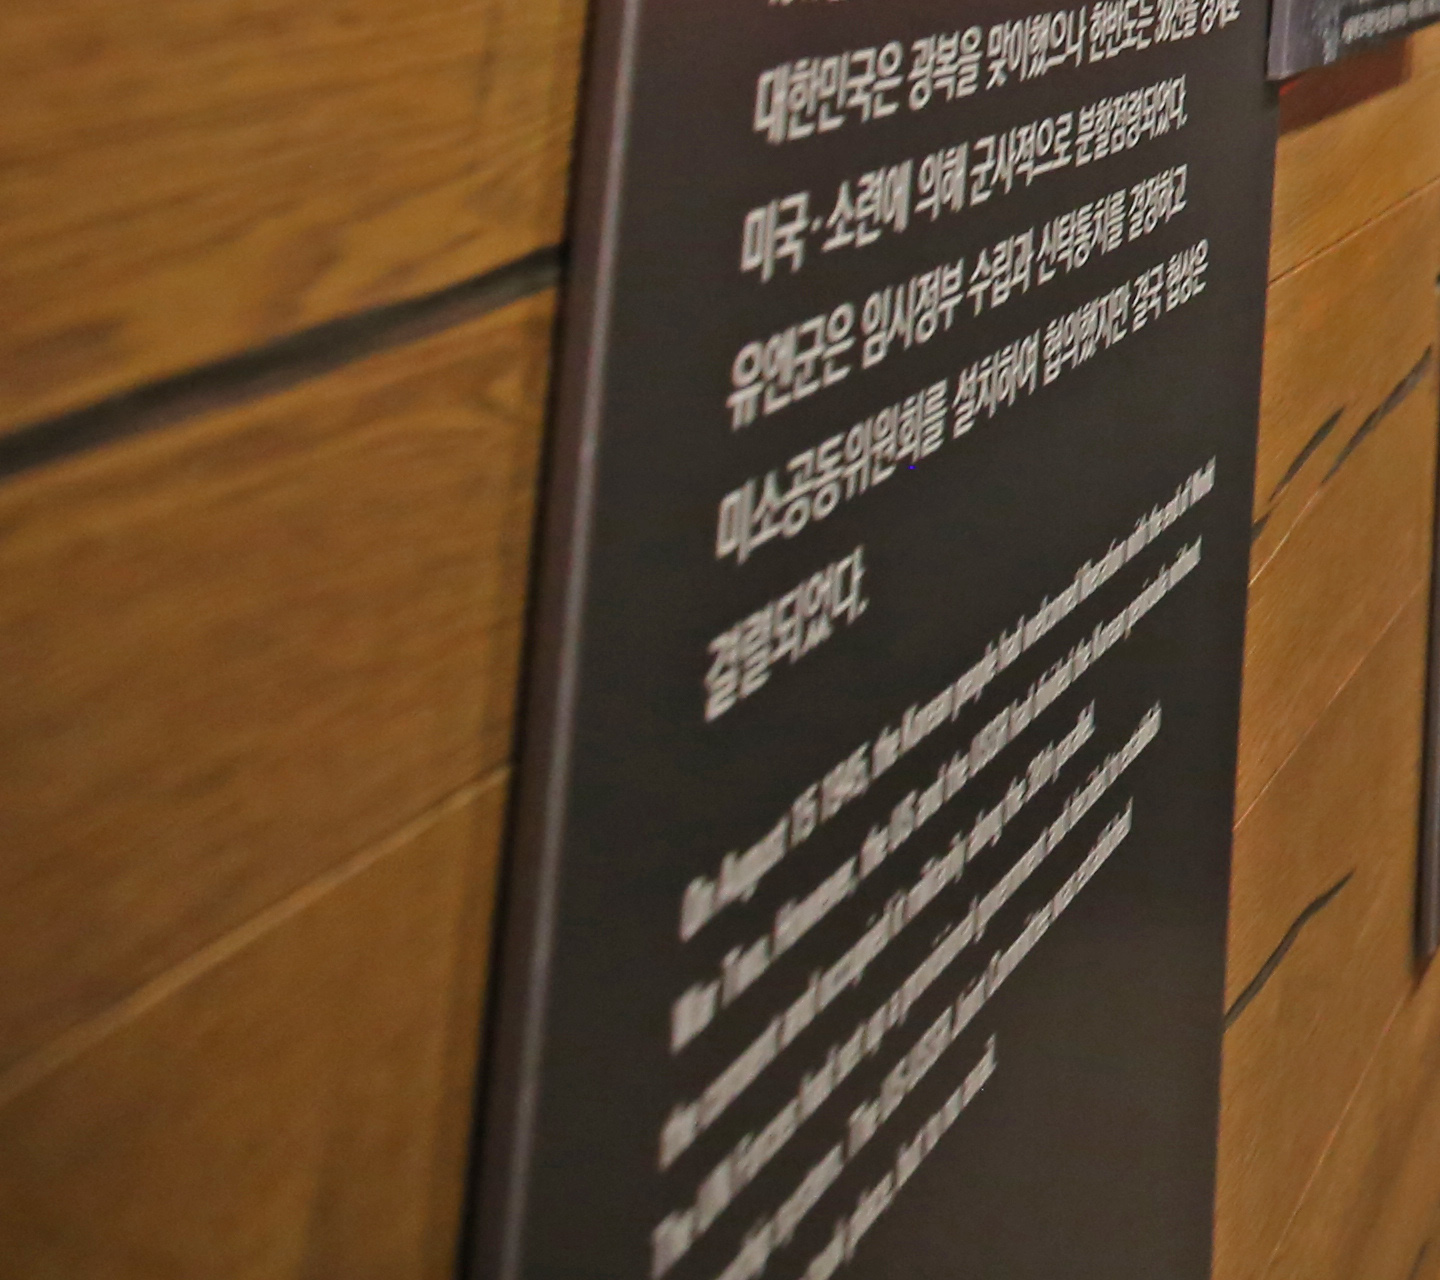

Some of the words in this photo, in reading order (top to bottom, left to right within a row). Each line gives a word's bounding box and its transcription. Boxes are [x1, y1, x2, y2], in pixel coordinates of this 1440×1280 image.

[753, 40, 904, 144] 대한민국은
[907, 25, 984, 112] 광복을
[986, 5, 1087, 90] 맞이했으나
[914, 140, 969, 222] 의해
[969, 111, 1074, 208] 군사적으로
[1074, 73, 1188, 168] 분할점령되었다.
[725, 302, 857, 432] 유엔군은
[861, 257, 965, 370] 임시정부
[966, 226, 1035, 318] 수립과
[1036, 187, 1127, 287] 신탁통치를
[1127, 163, 1188, 242] 결정하고
[715, 378, 949, 566] 미소공동위원회를
[951, 328, 1041, 440] 설치하여
[1042, 279, 1132, 388] 협의했지만
[1131, 262, 1165, 333] 결국
[1164, 238, 1209, 313] 협상은
[703, 543, 870, 723] 결렬되었다.
[871, 725, 901, 780] the
[900, 702, 953, 756] Korean
[951, 640, 999, 722] people
[998, 614, 1025, 676] had
